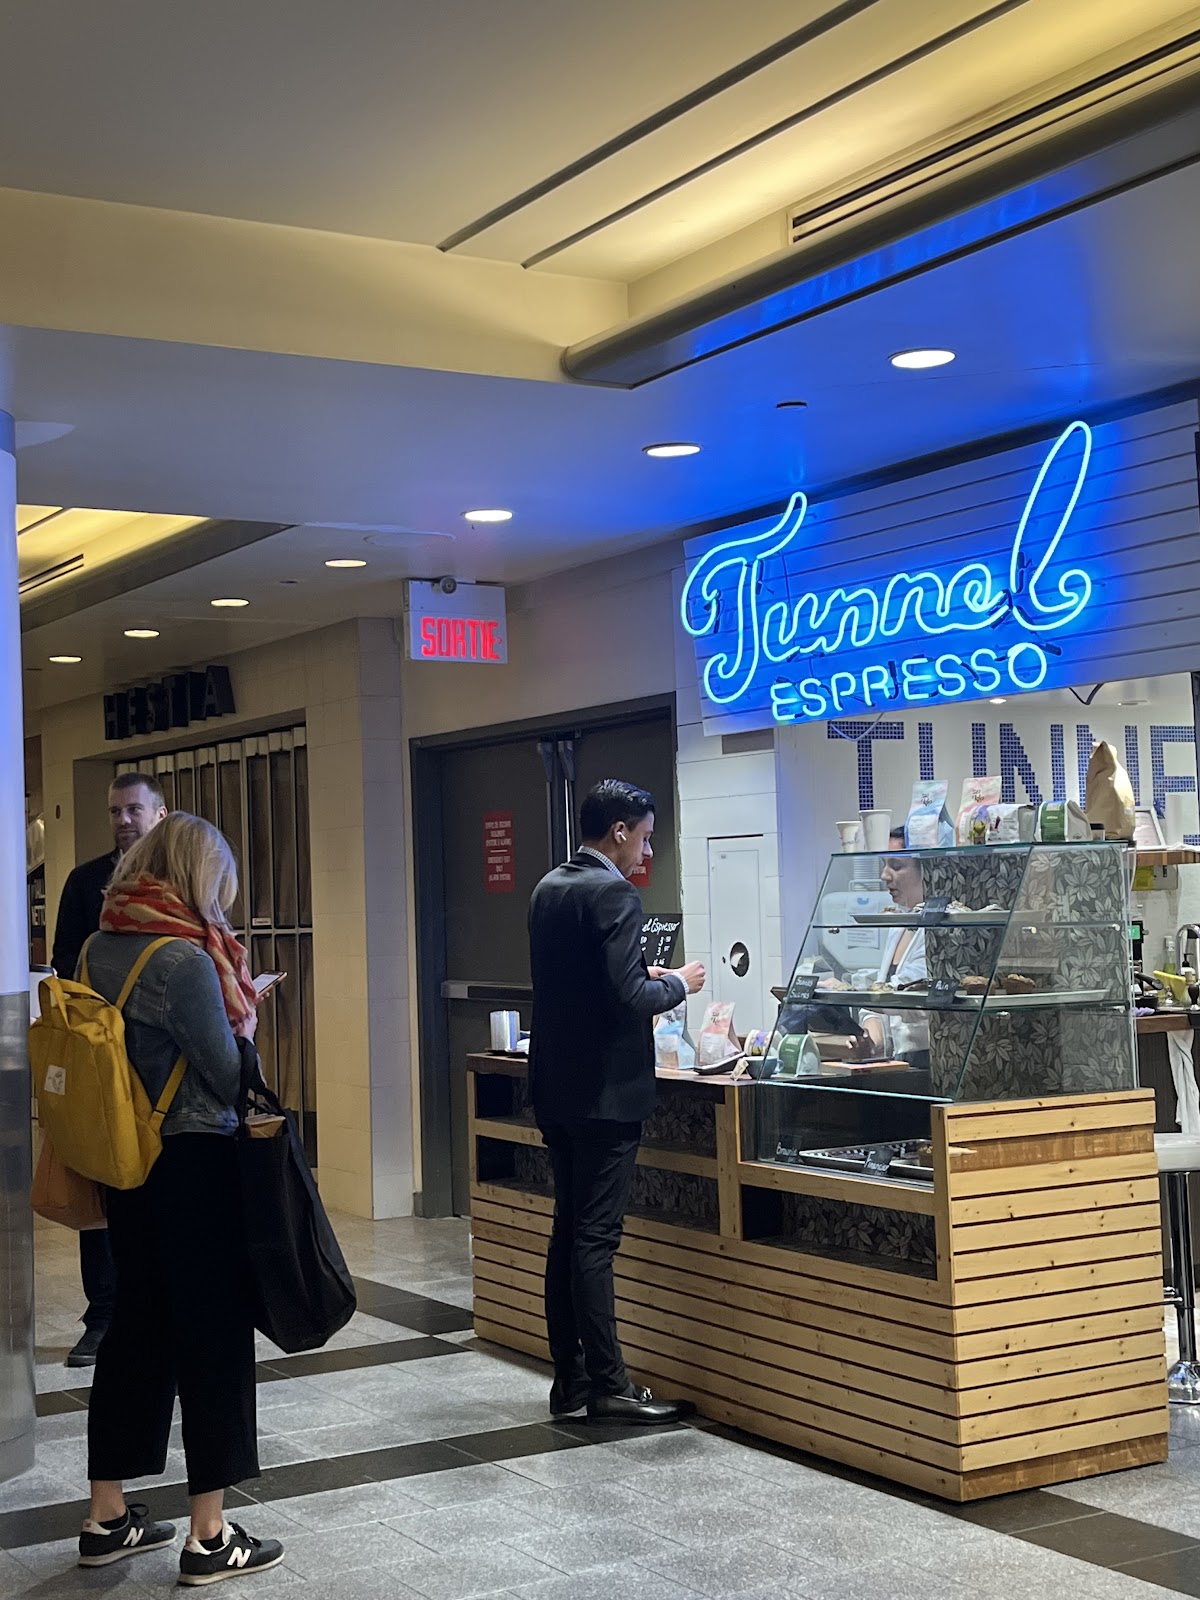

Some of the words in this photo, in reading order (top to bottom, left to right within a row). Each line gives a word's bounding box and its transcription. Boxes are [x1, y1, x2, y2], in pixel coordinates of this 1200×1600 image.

[680, 420, 1093, 705] Tunnel
[421, 616, 501, 660] SORTIE
[103, 665, 236, 740] HESTIA
[770, 641, 1048, 722] ESPRESSO
[122, 1526, 145, 1547] N
[226, 1546, 252, 1569] N
